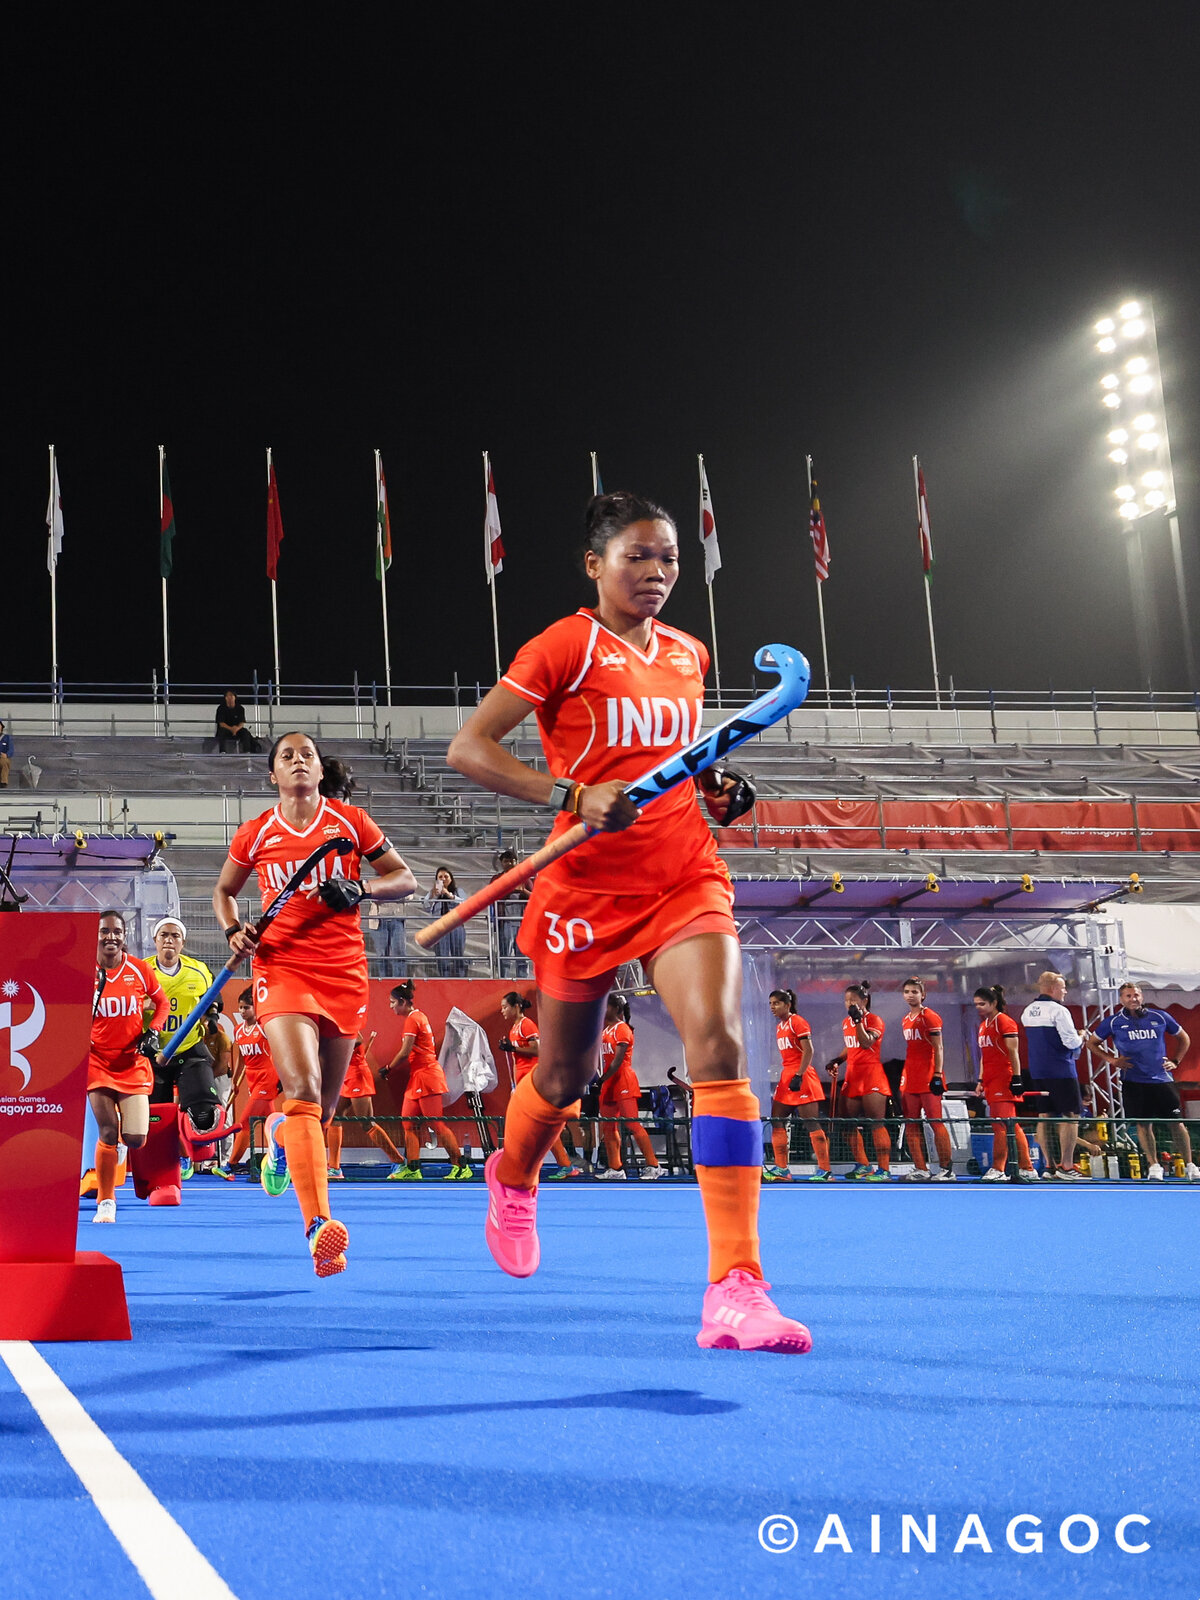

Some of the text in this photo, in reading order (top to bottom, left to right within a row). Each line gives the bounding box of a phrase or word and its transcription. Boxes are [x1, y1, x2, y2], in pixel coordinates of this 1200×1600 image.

[625, 718, 769, 804] ALFA
[544, 911, 595, 954] 30
[256, 976, 269, 1003] 6
[94, 994, 138, 1018] NDIA
[170, 997, 178, 1012] 9
[1128, 1029, 1158, 1041] INDIA
[35, 1104, 63, 1113] 2026
